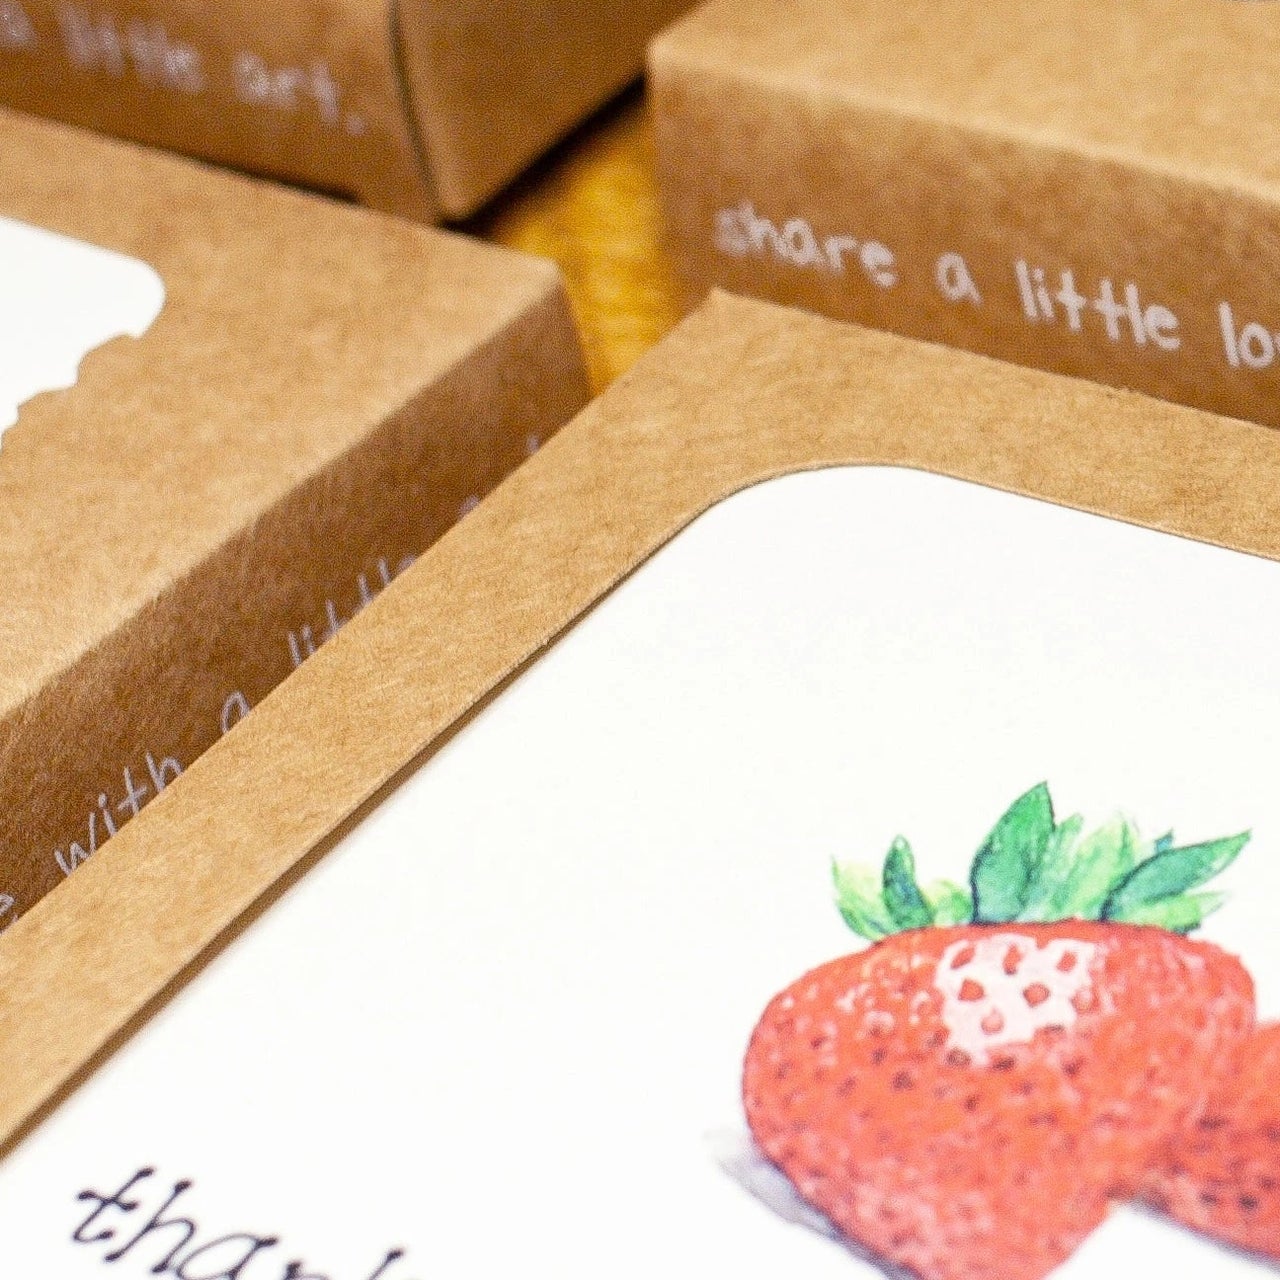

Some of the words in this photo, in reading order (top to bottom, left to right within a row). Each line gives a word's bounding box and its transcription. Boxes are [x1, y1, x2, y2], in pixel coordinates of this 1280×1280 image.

[714, 200, 897, 288] share
[935, 251, 982, 306] a
[1015, 259, 1182, 351] little
[72, 1165, 408, 1280] tha
